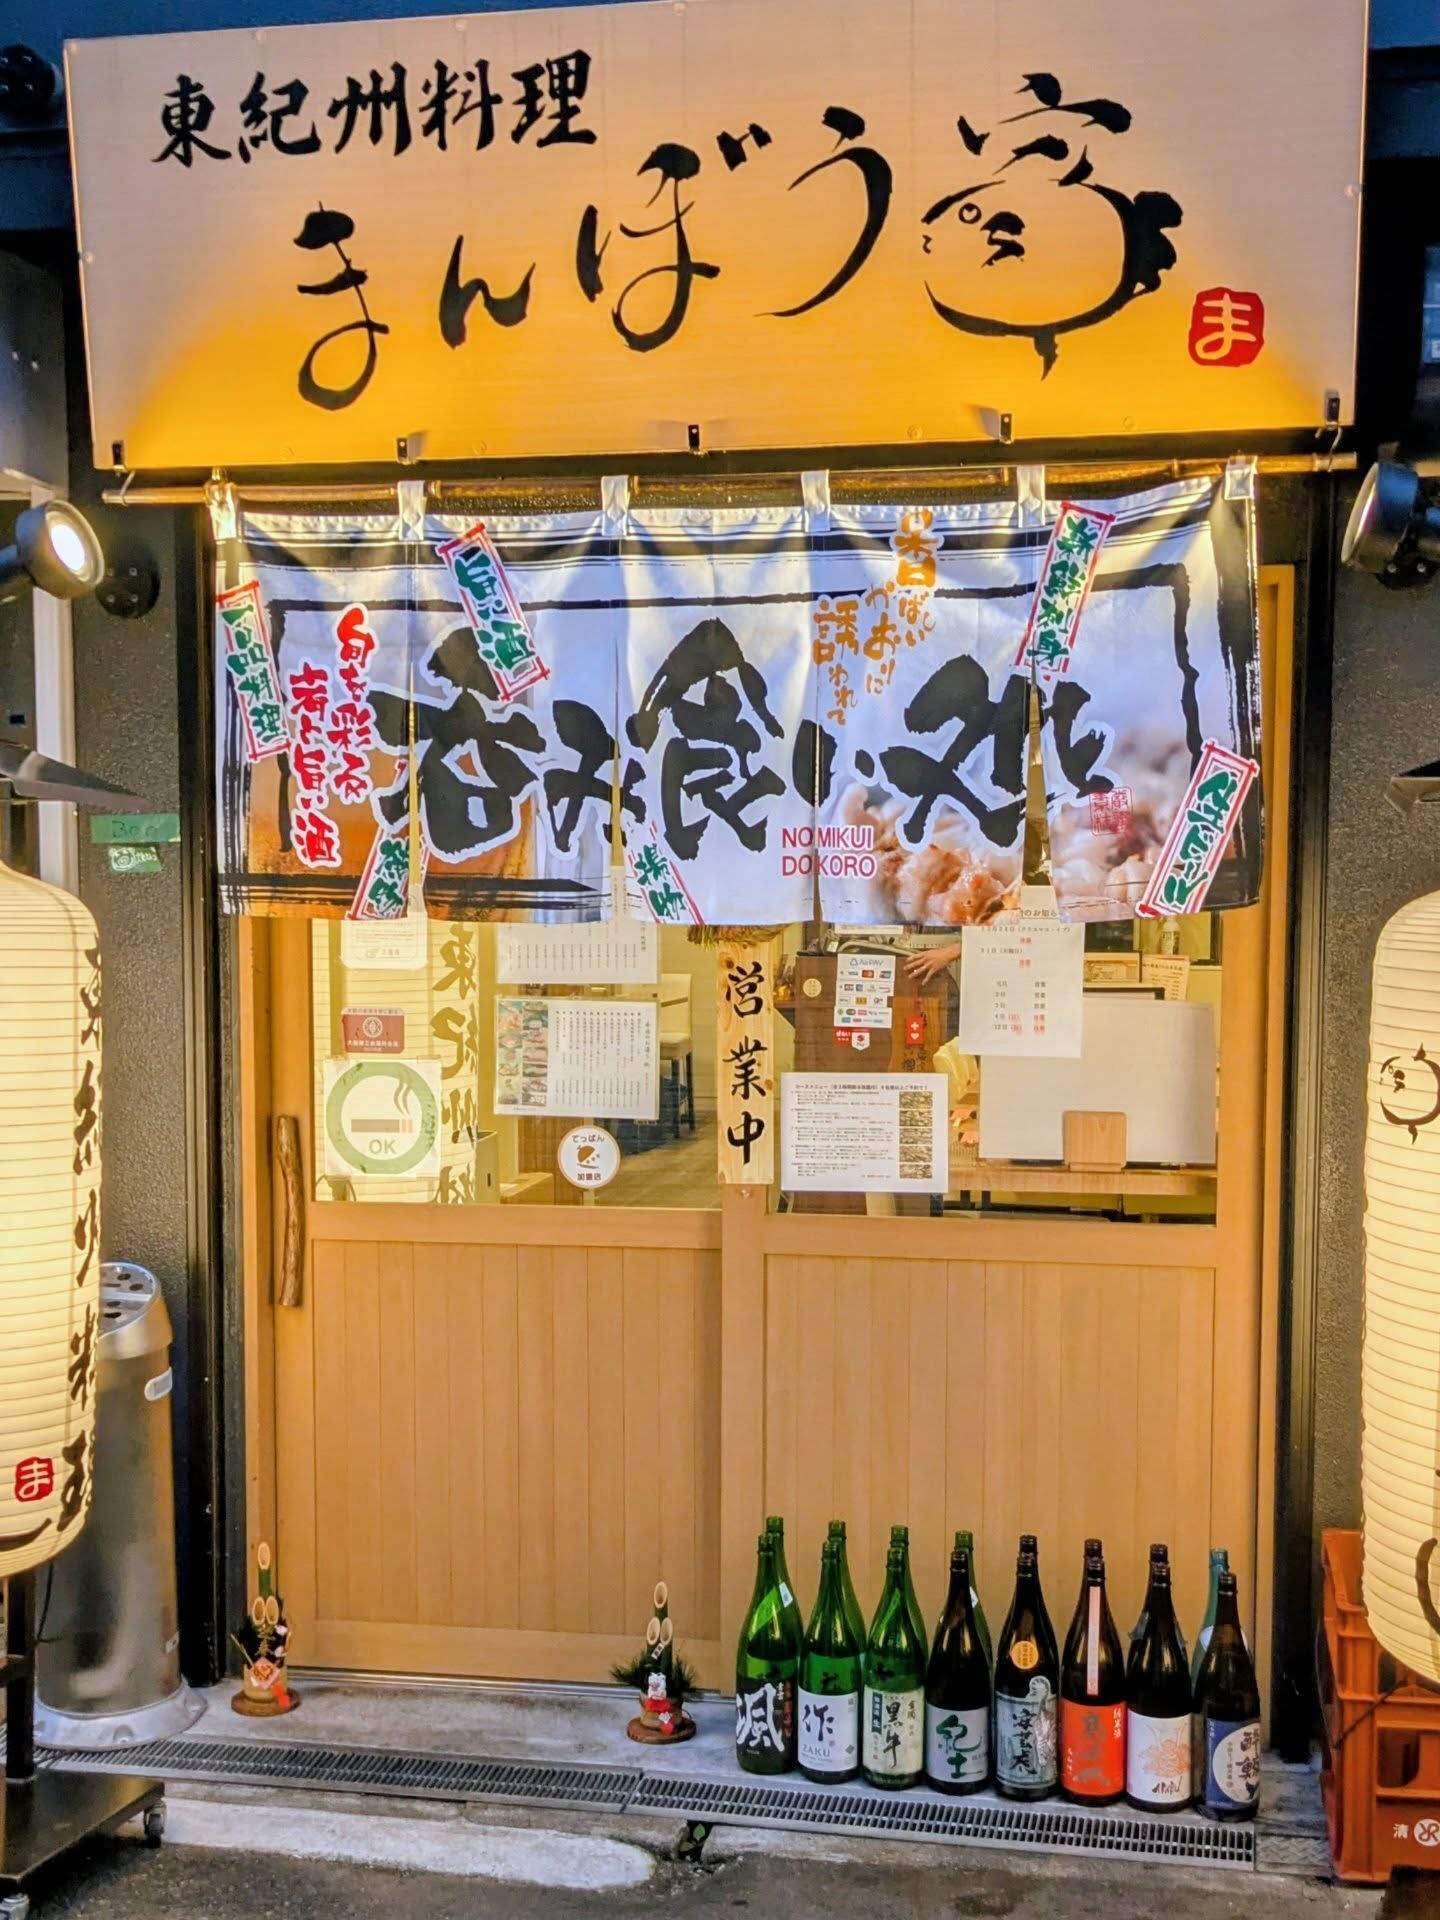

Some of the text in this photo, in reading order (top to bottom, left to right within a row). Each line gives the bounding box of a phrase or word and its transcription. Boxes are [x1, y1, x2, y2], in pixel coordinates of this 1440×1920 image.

[152, 49, 596, 168] 東紀州料理
[1193, 290, 1259, 362] ま
[454, 546, 536, 670] 旨い酒
[222, 604, 288, 743] 一品料理
[367, 617, 1115, 861] 呑み食い処
[782, 826, 875, 850] NOMIKUI
[782, 855, 877, 878] DOKORO
[722, 960, 768, 1166] 営業中
[368, 1138, 396, 1155] OK
[17, 1458, 53, 1501] ま
[803, 1703, 835, 1742] 作
[882, 1701, 905, 1769] 黒牛
